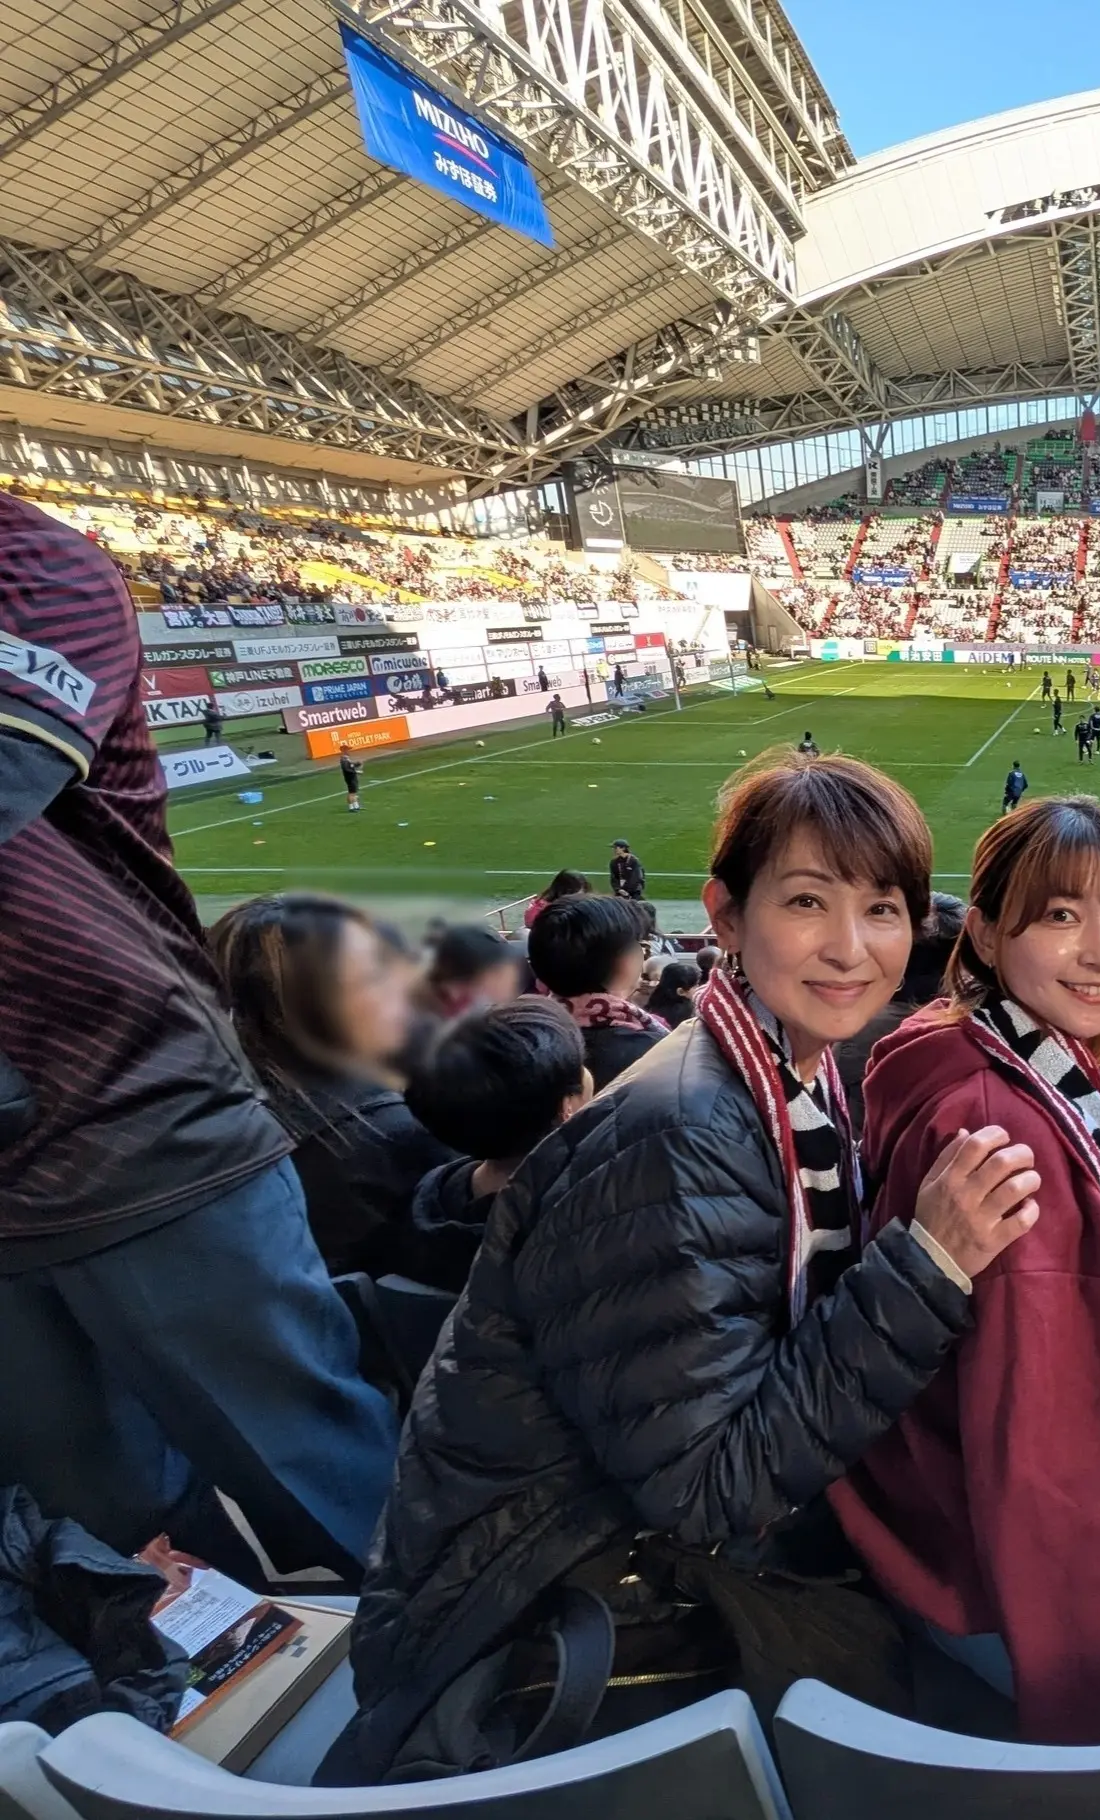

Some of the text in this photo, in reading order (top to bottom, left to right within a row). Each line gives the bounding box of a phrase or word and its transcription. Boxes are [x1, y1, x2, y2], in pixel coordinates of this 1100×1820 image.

[413, 90, 490, 159] MIZUHO
[433, 151, 498, 203] みずほ証券
[384, 657, 427, 671] micware
[899, 651, 942, 661] 明治安田
[1026, 655, 1052, 664] ROUTE
[302, 660, 365, 677] MORESCO
[323, 681, 368, 695] PRIME JAPAN
[524, 676, 562, 692] Smaweb
[256, 692, 290, 708] izuhei
[146, 704, 167, 723] K
[298, 702, 367, 727] Smartweb
[349, 732, 391, 746] OUTLET PARK
[162, 753, 235, 777] グループ
